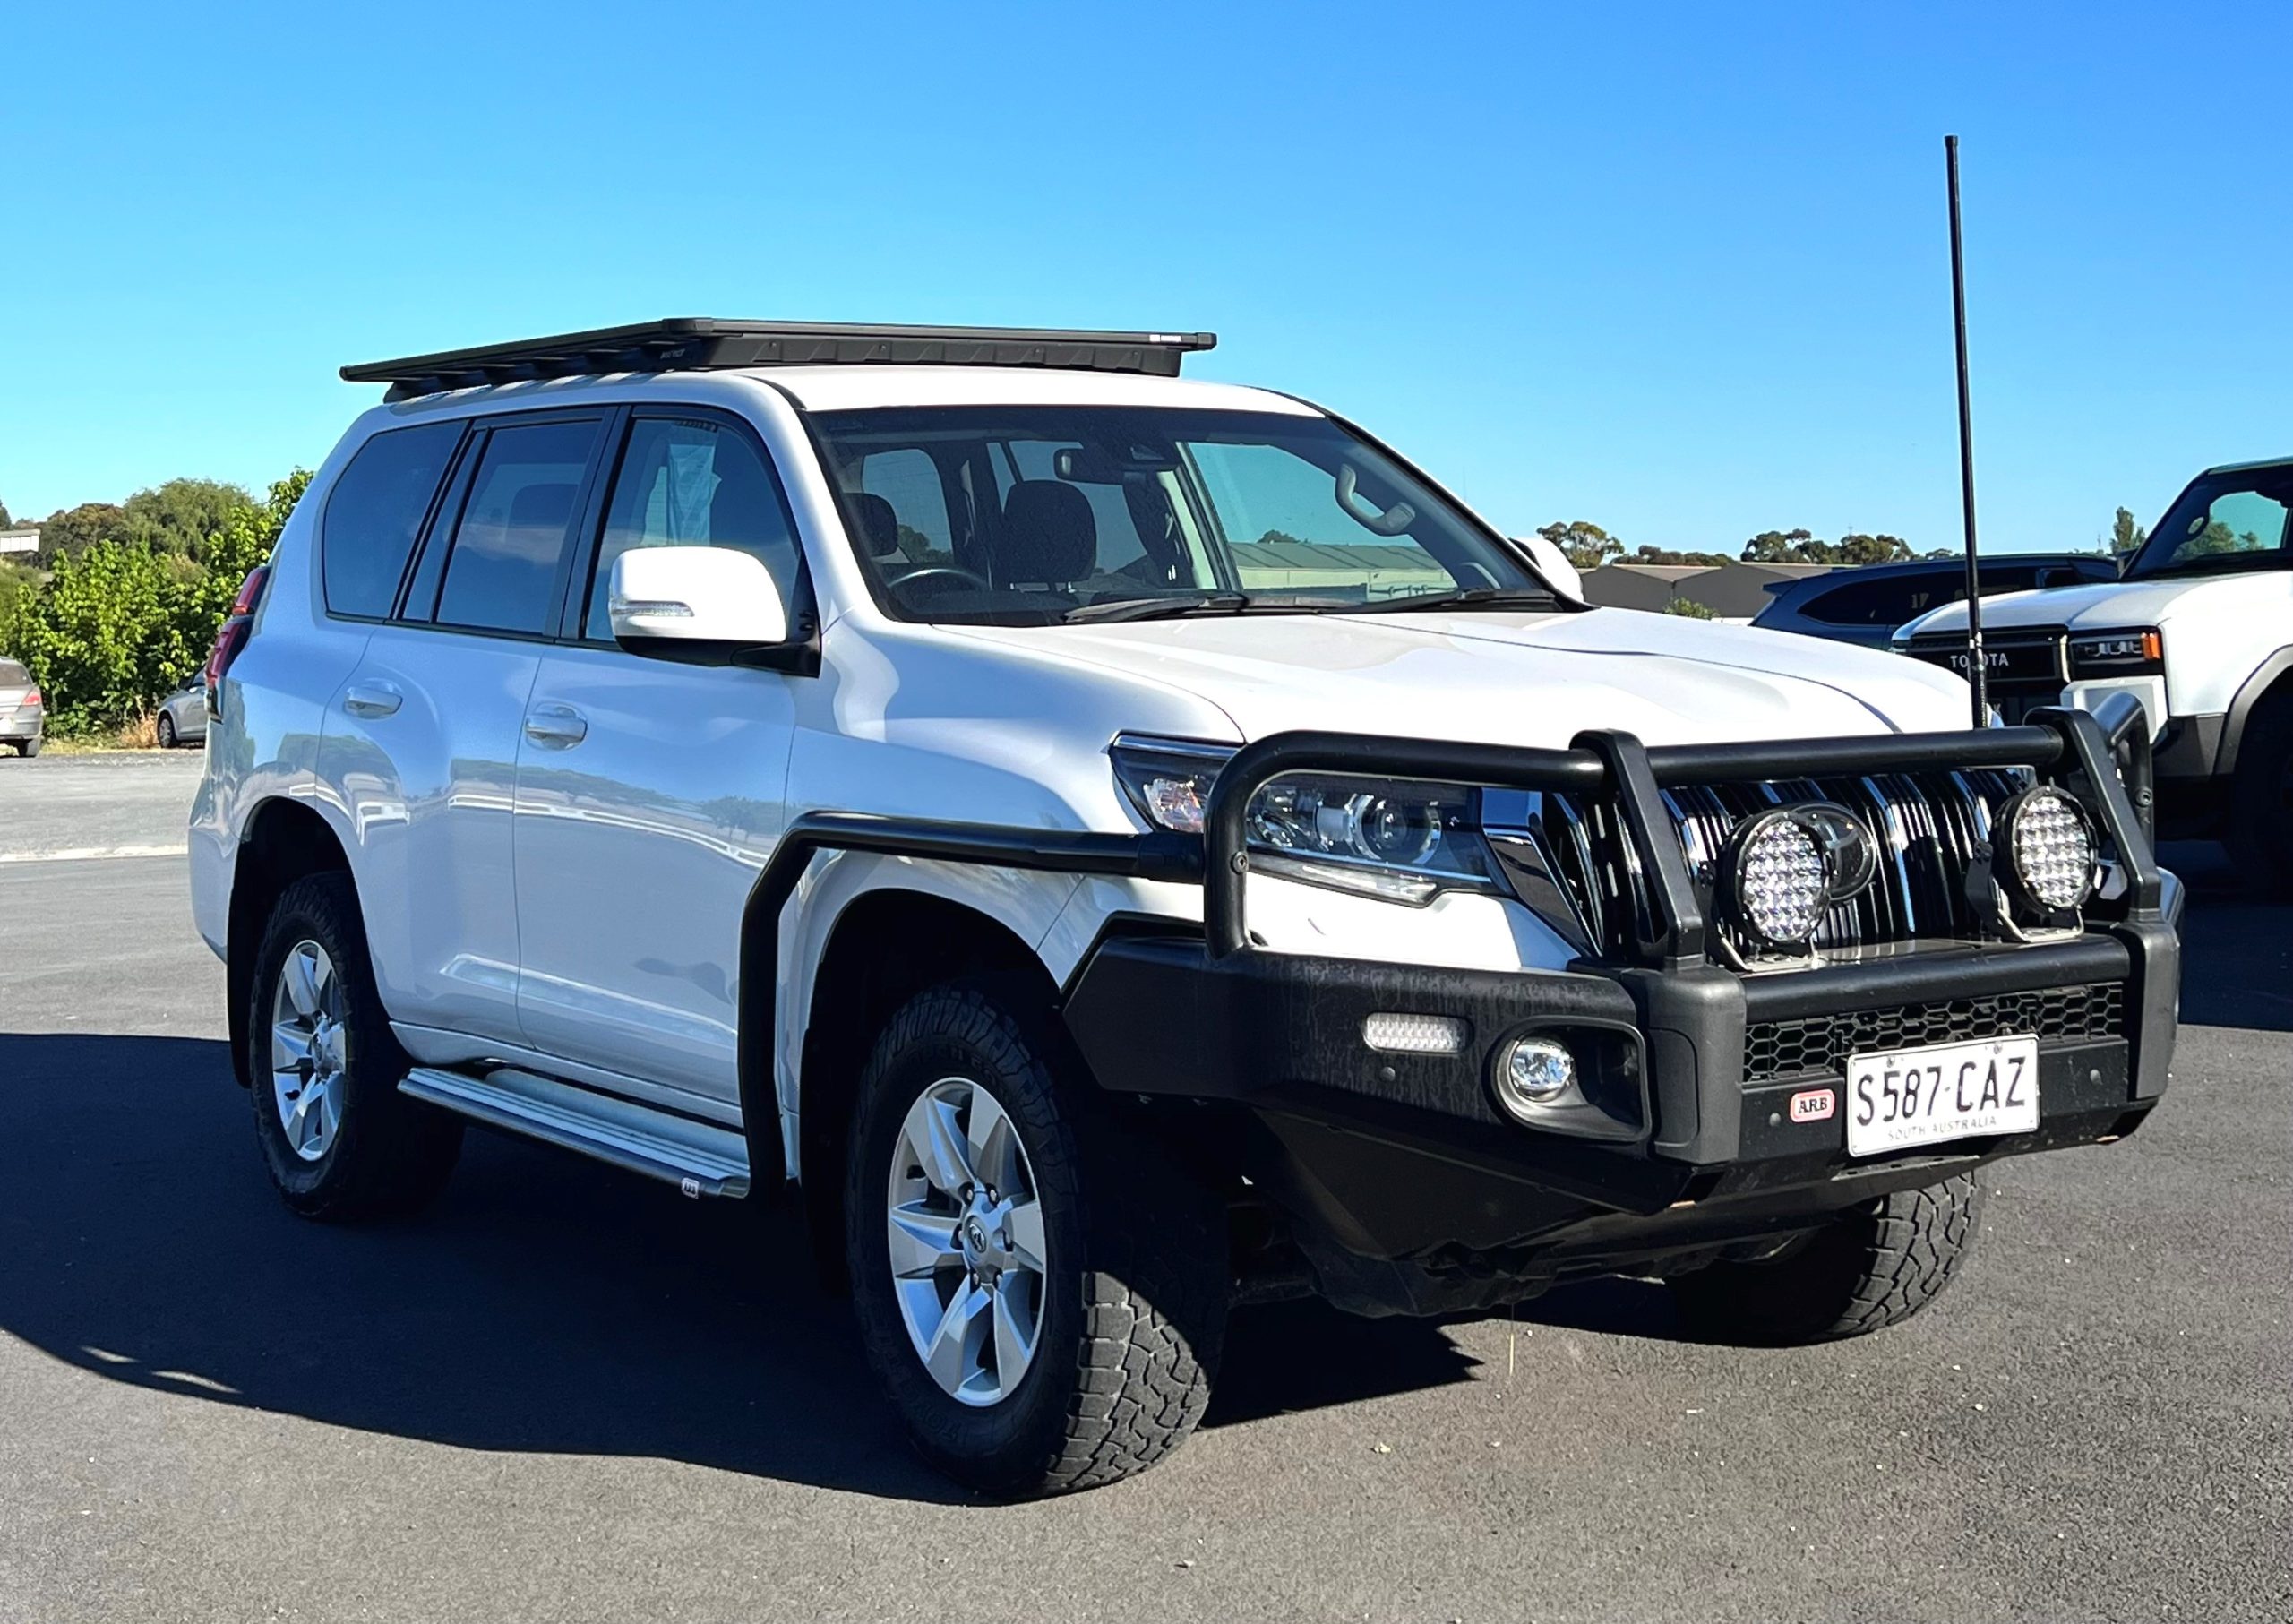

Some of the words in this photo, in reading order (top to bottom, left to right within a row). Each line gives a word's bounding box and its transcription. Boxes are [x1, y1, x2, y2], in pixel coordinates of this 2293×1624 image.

[1949, 652, 2009, 669] TOOTA
[1798, 1096, 1828, 1114] ARB
[1887, 1125, 1926, 1142] SOUTH
[1932, 1115, 1997, 1134] AUSTRALIA
